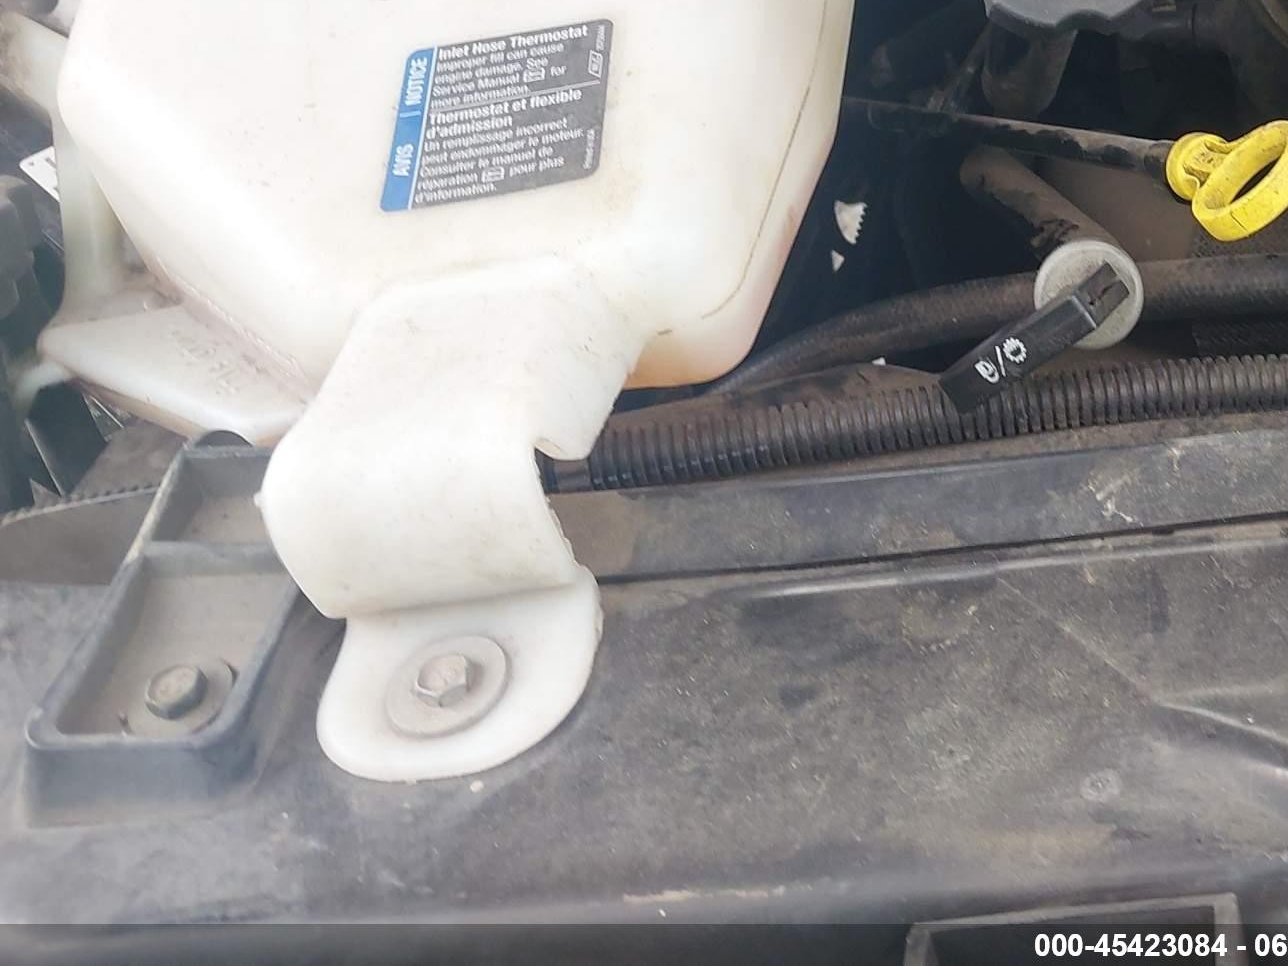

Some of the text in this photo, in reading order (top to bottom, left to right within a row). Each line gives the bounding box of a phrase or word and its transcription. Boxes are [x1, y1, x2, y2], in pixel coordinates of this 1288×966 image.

[436, 42, 564, 74] Improper fill can cause
[438, 45, 470, 61] Inlet
[472, 40, 506, 55] Hose
[510, 24, 588, 49] Thermostat
[405, 57, 428, 106] NOTICE
[432, 65, 567, 98] Service Manual for
[434, 70, 473, 85] engine
[526, 57, 549, 70] See
[429, 88, 582, 125] Thermostat et flexible
[430, 95, 461, 110] more
[424, 117, 567, 153] Un remplissage incorrect
[426, 115, 513, 140] d'admission
[528, 136, 540, 148] le
[392, 144, 414, 176] AVIS
[420, 146, 553, 179] Consulter le manuel de
[509, 162, 537, 178] pour
[539, 156, 565, 172] plus
